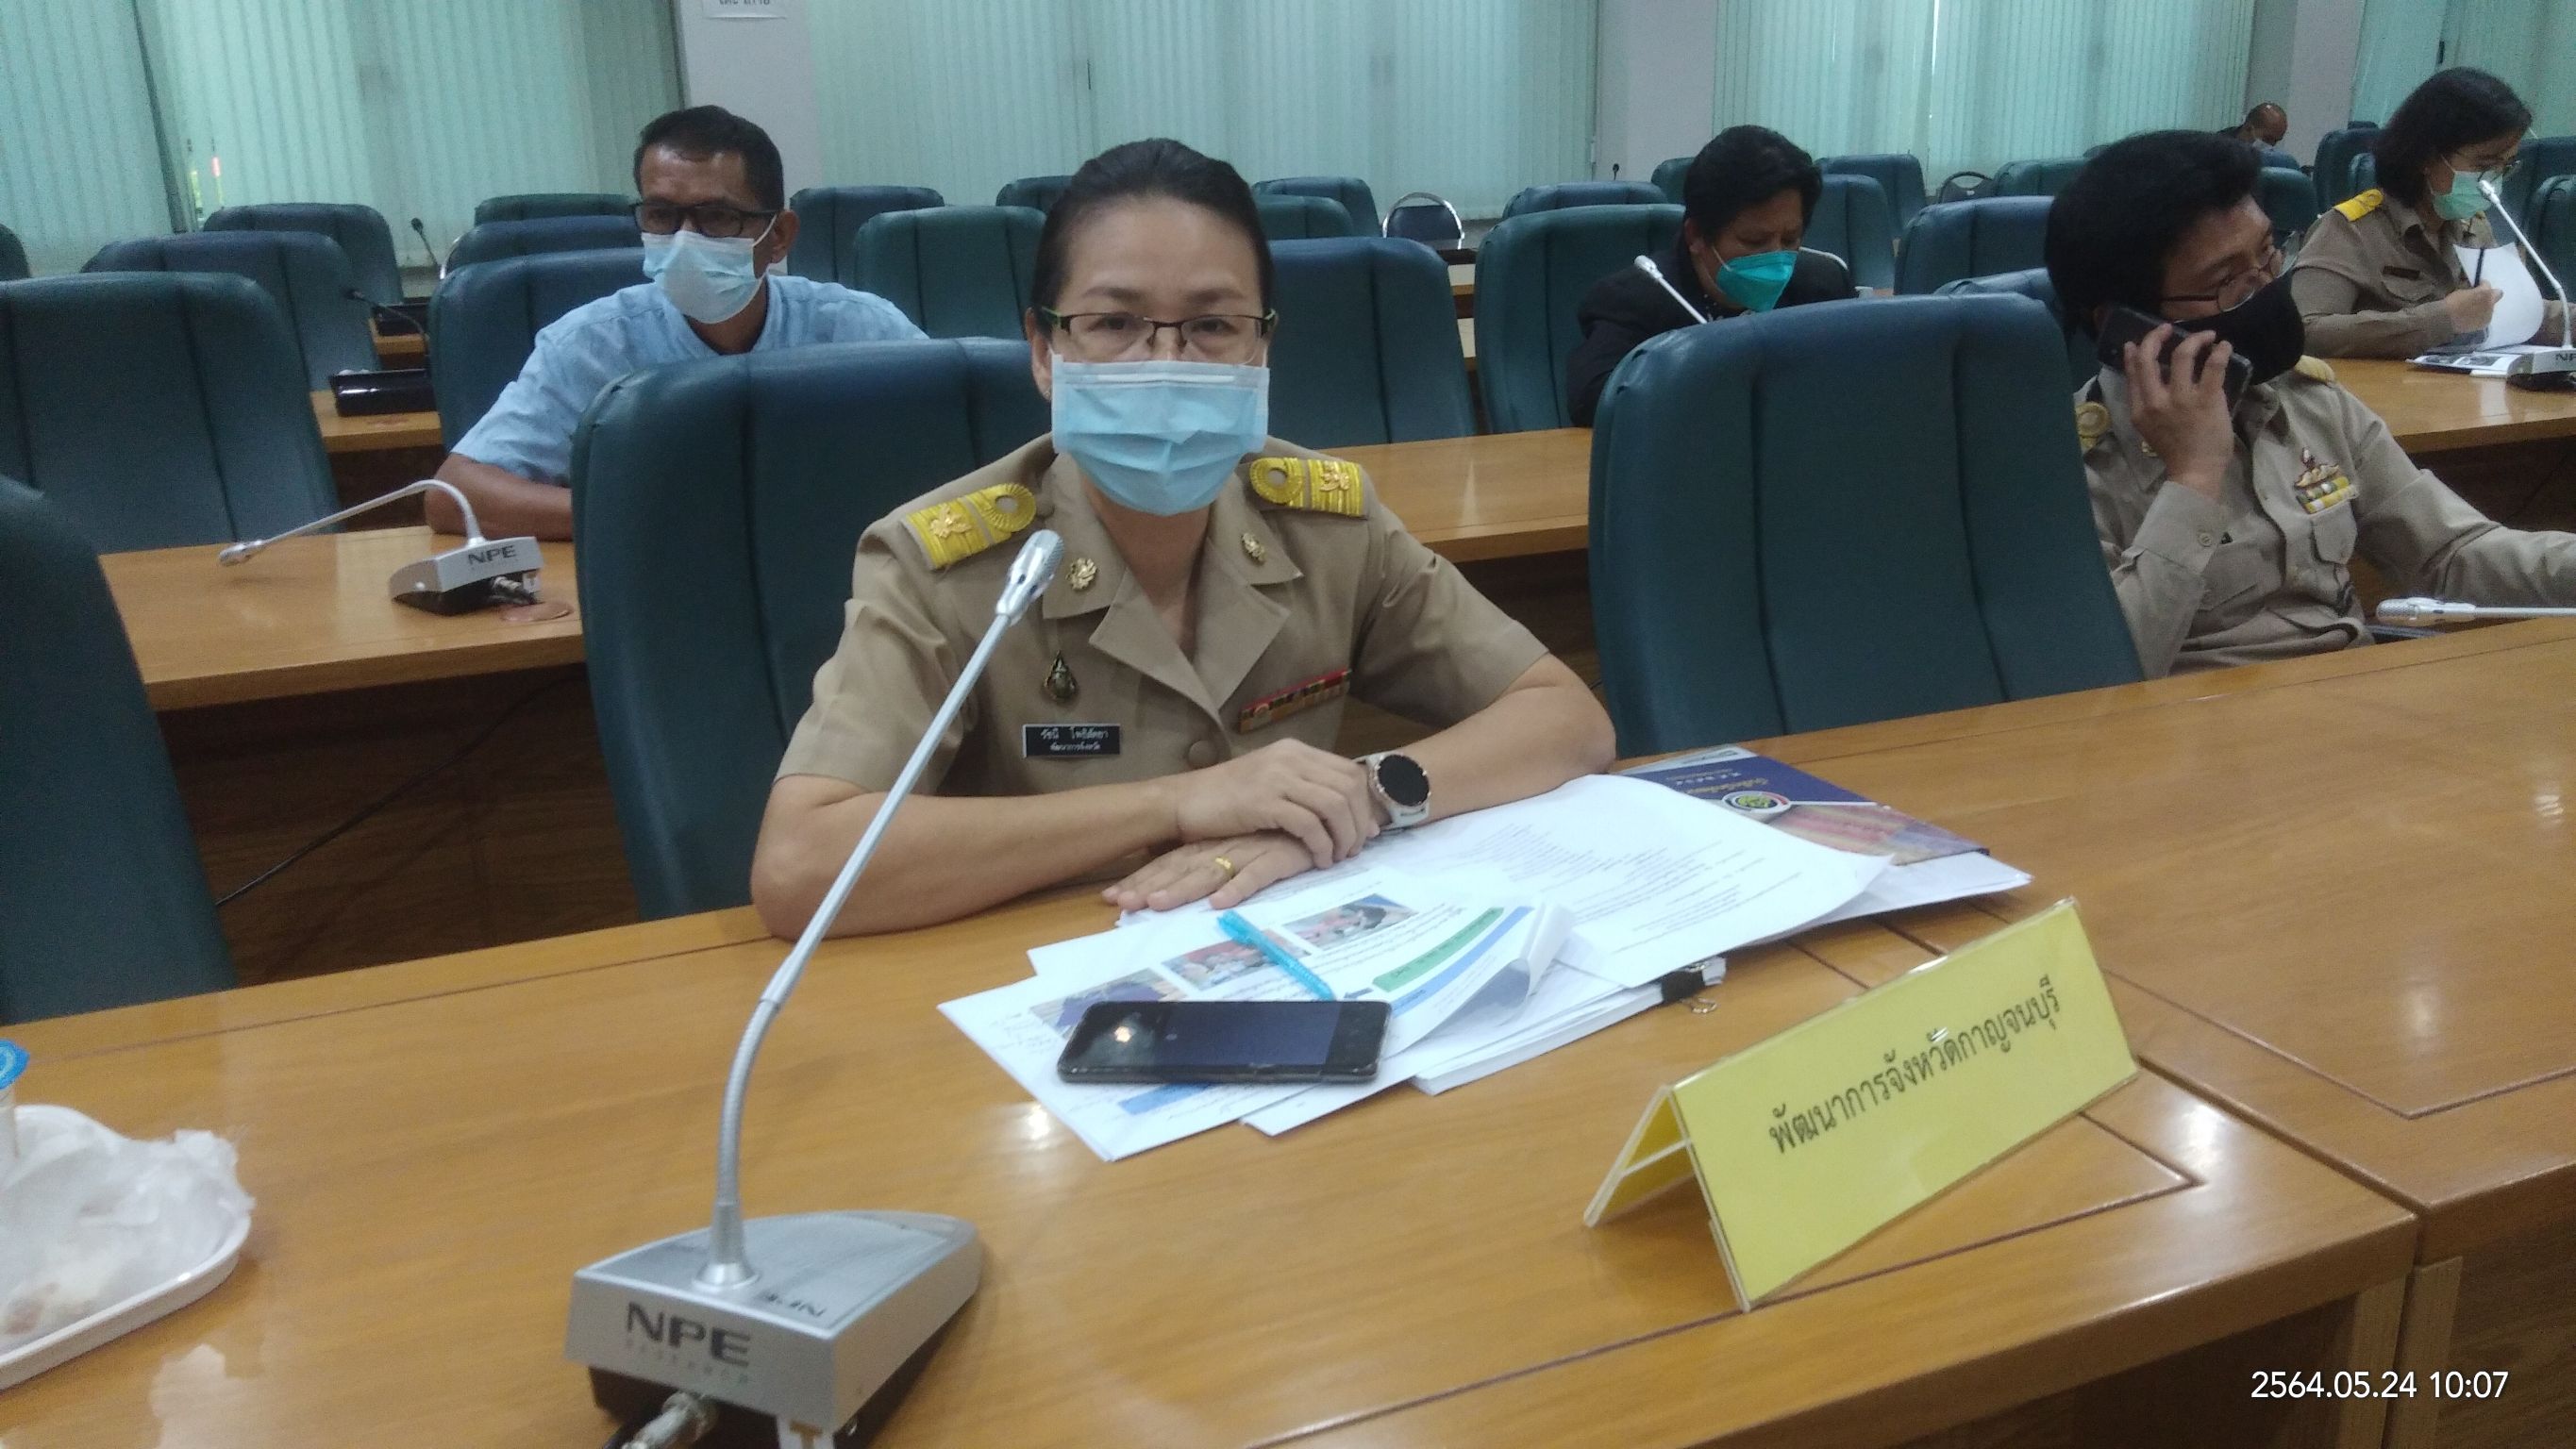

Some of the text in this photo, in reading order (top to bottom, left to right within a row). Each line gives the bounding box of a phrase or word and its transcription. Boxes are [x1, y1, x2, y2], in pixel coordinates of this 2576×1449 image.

[468, 545, 516, 564] NPE
[1768, 974, 2061, 1154] พัฒนาการจังหวัดกาญจนบุรี
[627, 1301, 751, 1366] NPE
